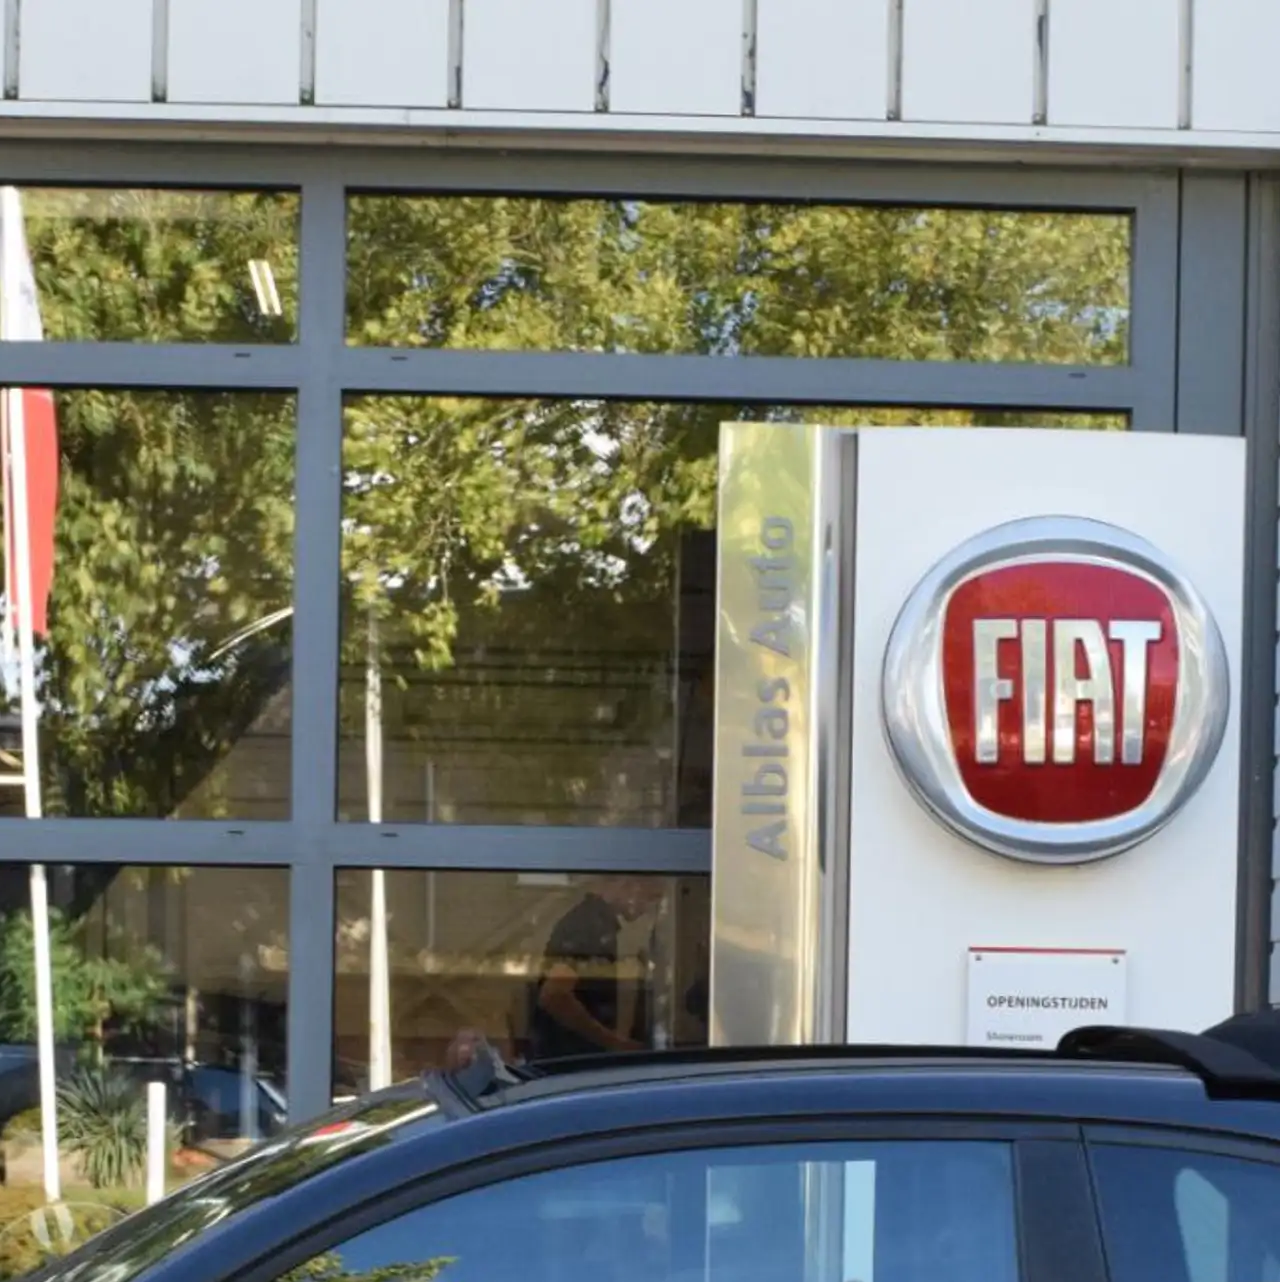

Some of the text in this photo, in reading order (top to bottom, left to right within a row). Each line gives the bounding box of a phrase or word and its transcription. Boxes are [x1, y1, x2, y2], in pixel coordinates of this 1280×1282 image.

[740, 516, 794, 862] Alblas Auto
[972, 618, 1162, 765] FIAT
[986, 995, 1108, 1010] OPENINGSTIJDEN
